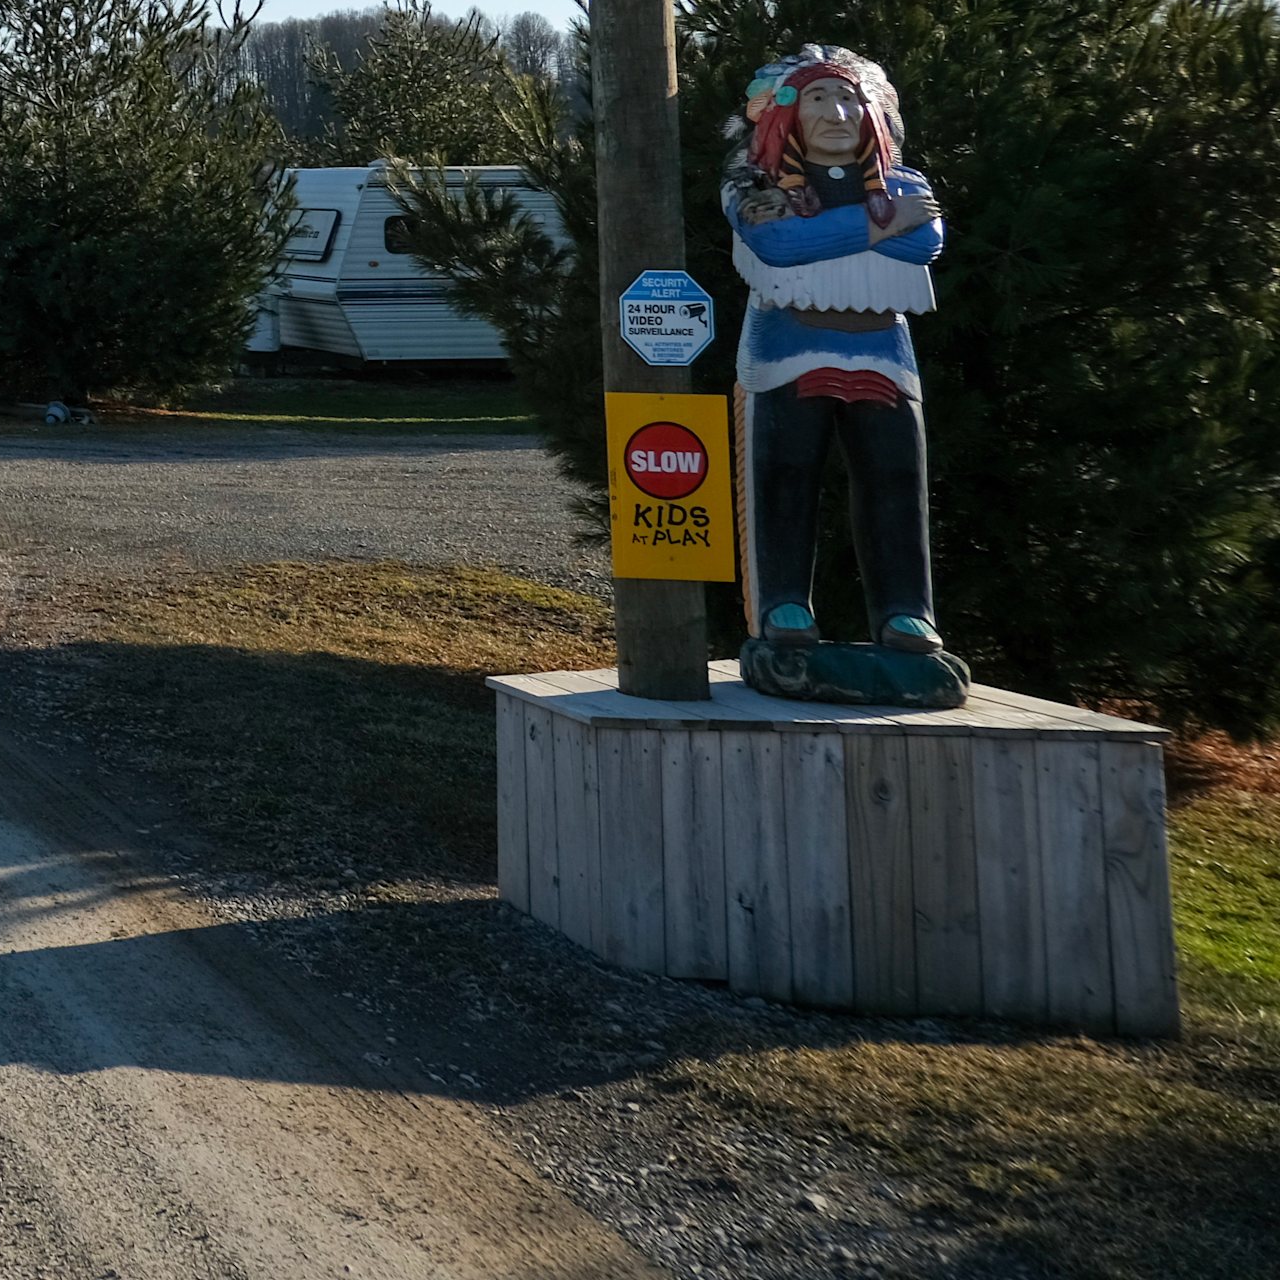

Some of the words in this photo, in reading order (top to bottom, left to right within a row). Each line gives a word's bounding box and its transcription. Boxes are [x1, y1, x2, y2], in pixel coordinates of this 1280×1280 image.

[642, 278, 688, 287] SECURITY
[651, 289, 681, 297] ALERT
[628, 304, 640, 313] 24
[644, 304, 675, 314] HOUR
[628, 315, 663, 326] VIDEO
[628, 327, 694, 336] SURVEILLANCE
[631, 450, 701, 473] SLOW
[633, 503, 710, 528] KIDS
[632, 533, 648, 545] AT
[652, 528, 710, 547] PLAY
